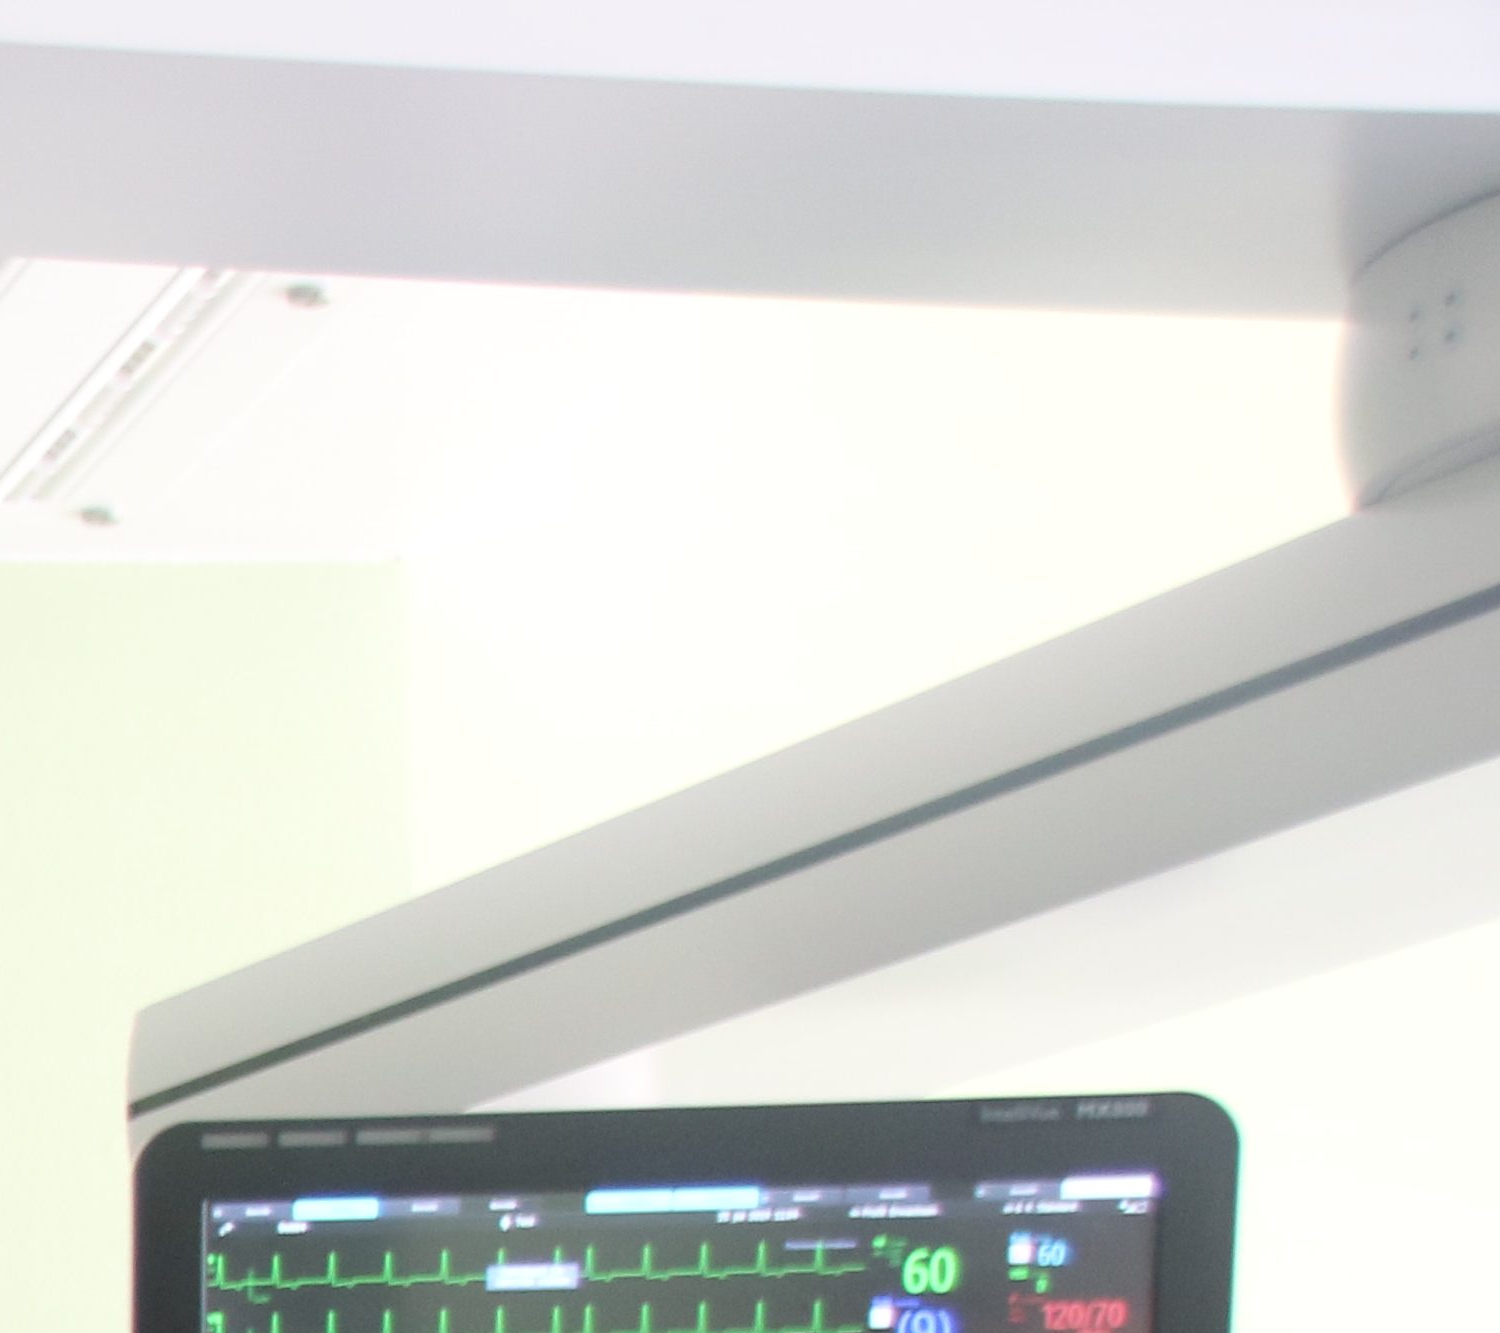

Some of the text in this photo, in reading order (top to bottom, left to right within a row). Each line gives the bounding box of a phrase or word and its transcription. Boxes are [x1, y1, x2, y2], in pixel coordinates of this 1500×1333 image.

[1037, 1240, 1067, 1266] 60
[903, 1247, 958, 1294] 60
[1042, 1301, 1128, 1330] 120/70
